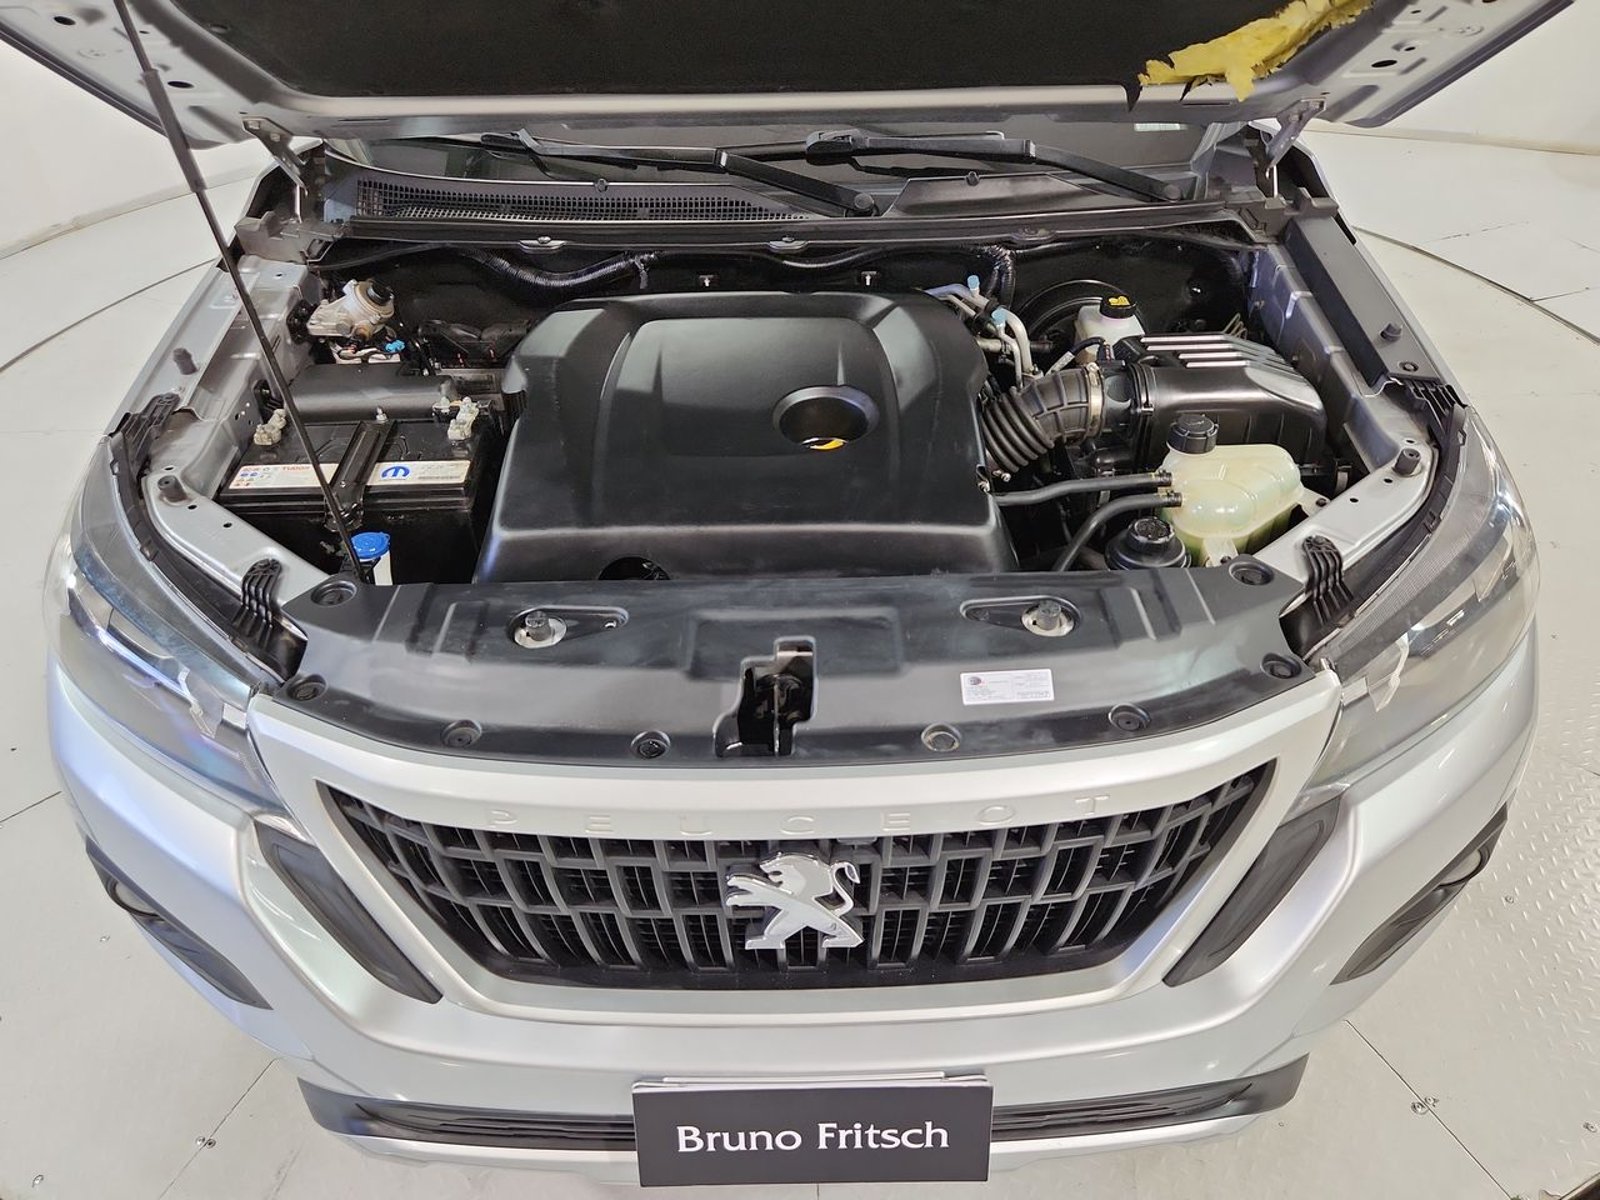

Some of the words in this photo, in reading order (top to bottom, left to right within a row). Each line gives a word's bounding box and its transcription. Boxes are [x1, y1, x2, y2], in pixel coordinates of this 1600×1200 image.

[487, 793, 1111, 836] PEUGEOT
[676, 1125, 802, 1152] Bruno
[817, 1121, 949, 1149] Fritsch
